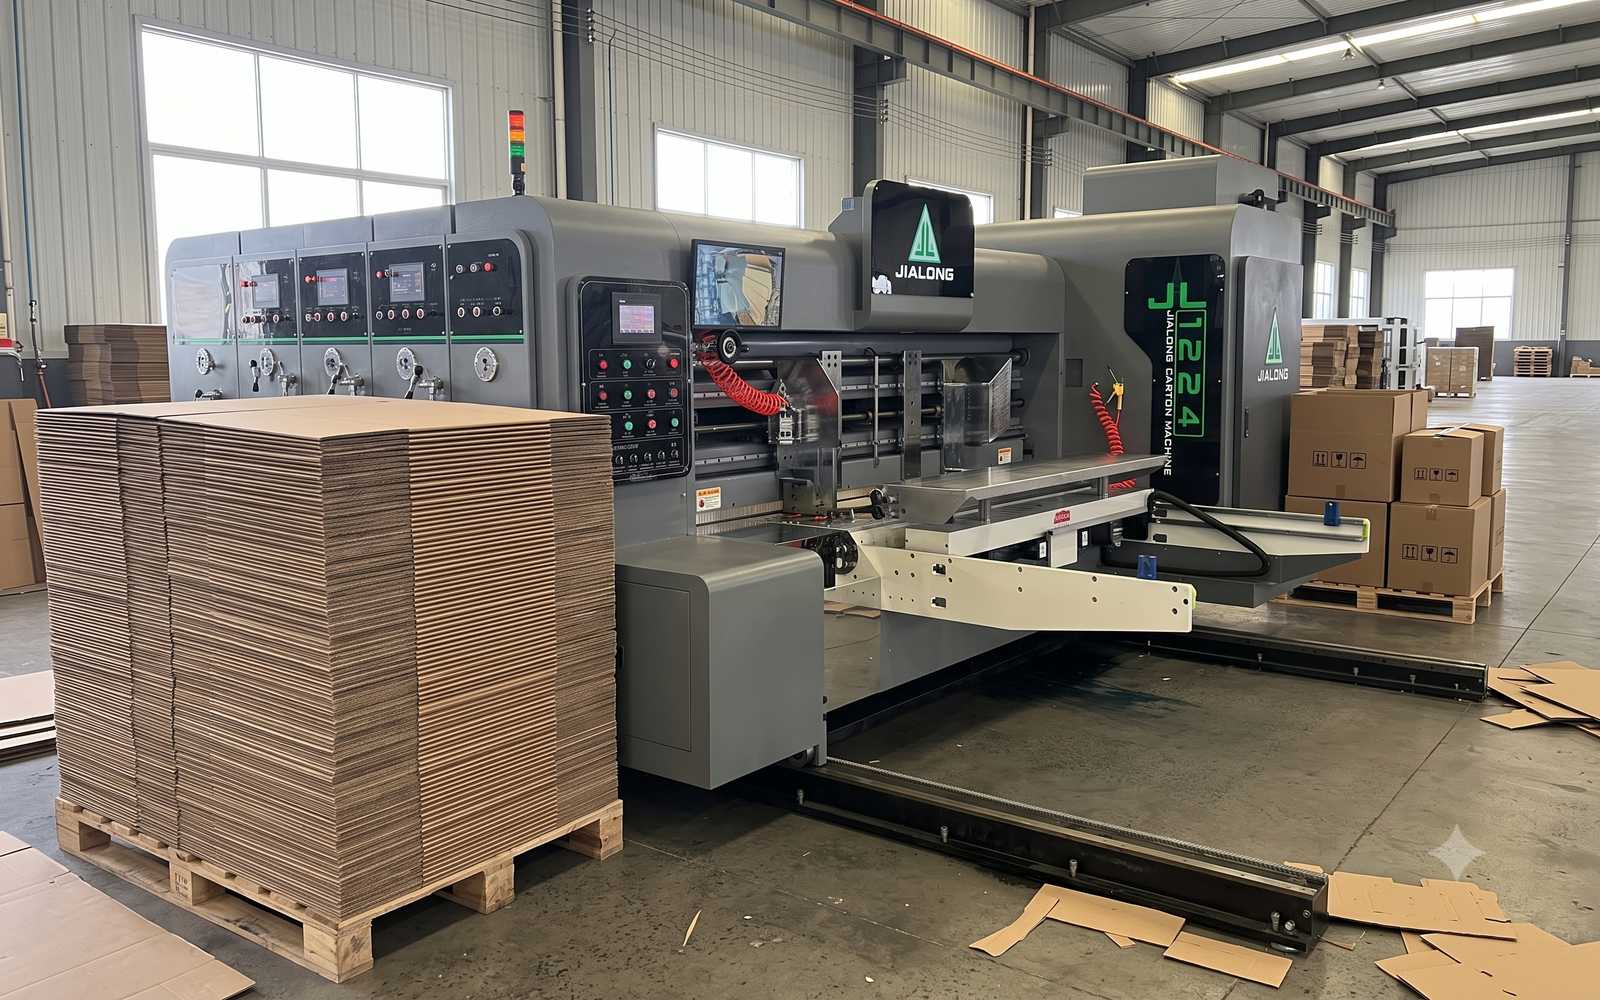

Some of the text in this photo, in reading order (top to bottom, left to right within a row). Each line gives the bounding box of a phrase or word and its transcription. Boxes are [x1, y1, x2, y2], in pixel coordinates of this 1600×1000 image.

[895, 264, 954, 281] JIALONG
[1148, 282, 1206, 309] JL
[1165, 310, 1174, 363] JIALONG
[1178, 317, 1202, 428] 1224
[1257, 368, 1289, 382] JIALONG
[1164, 367, 1173, 417] CARTON
